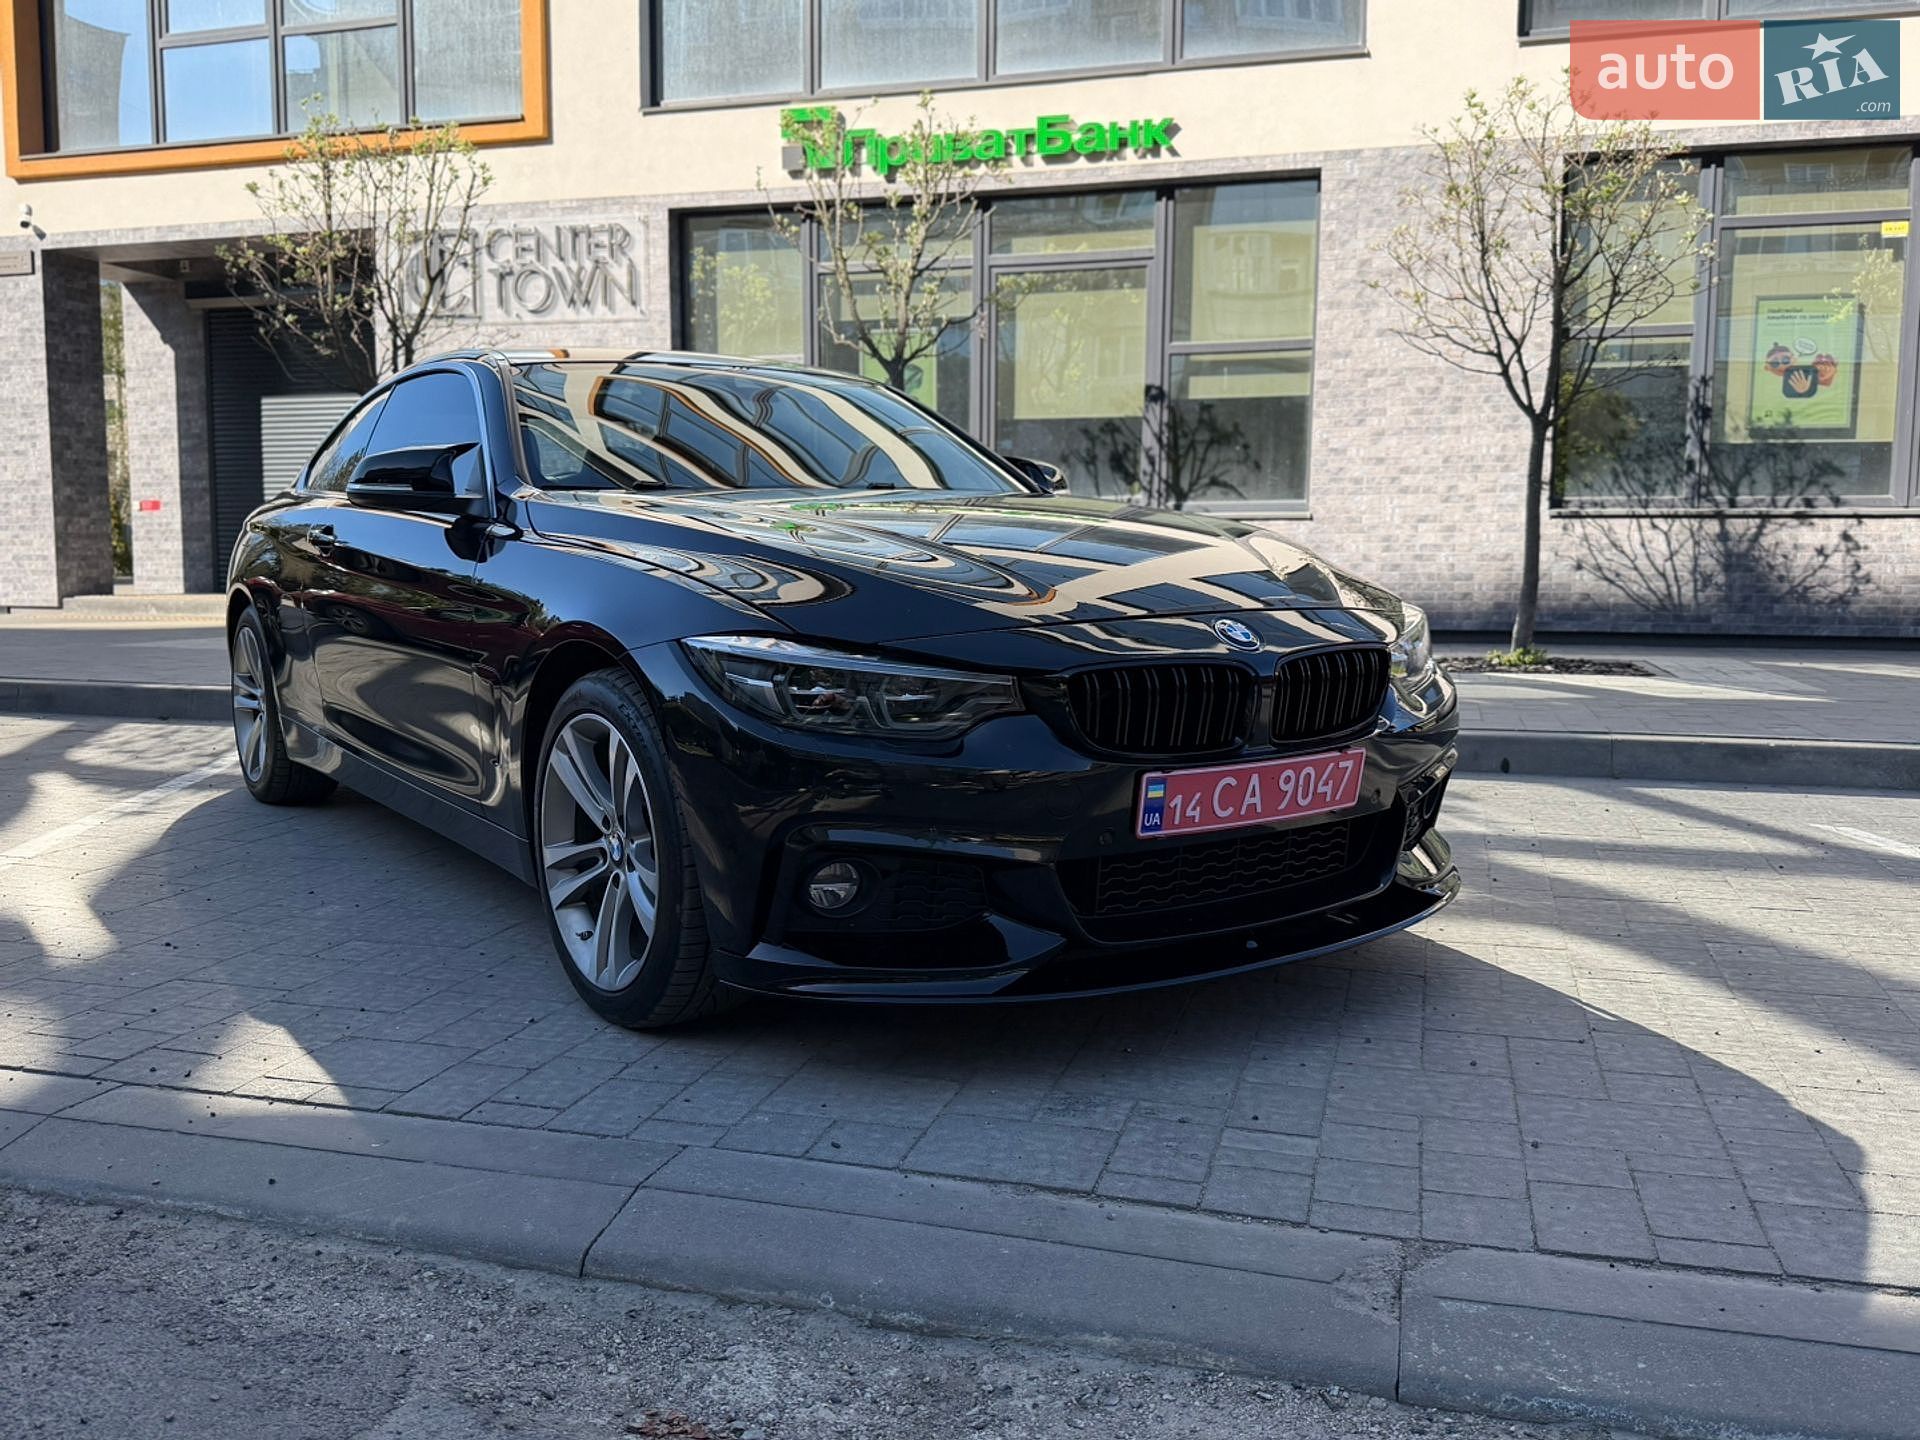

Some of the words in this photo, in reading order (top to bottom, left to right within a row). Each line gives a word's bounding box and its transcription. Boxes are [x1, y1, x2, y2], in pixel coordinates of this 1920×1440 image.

[843, 114, 1173, 175] ПриватБанк
[486, 222, 632, 265] CENTER
[488, 258, 639, 314] TOWN
[1144, 813, 1161, 827] UA
[1168, 792, 1201, 825] 14
[1212, 773, 1262, 818] CA
[1278, 760, 1355, 810] 9047
